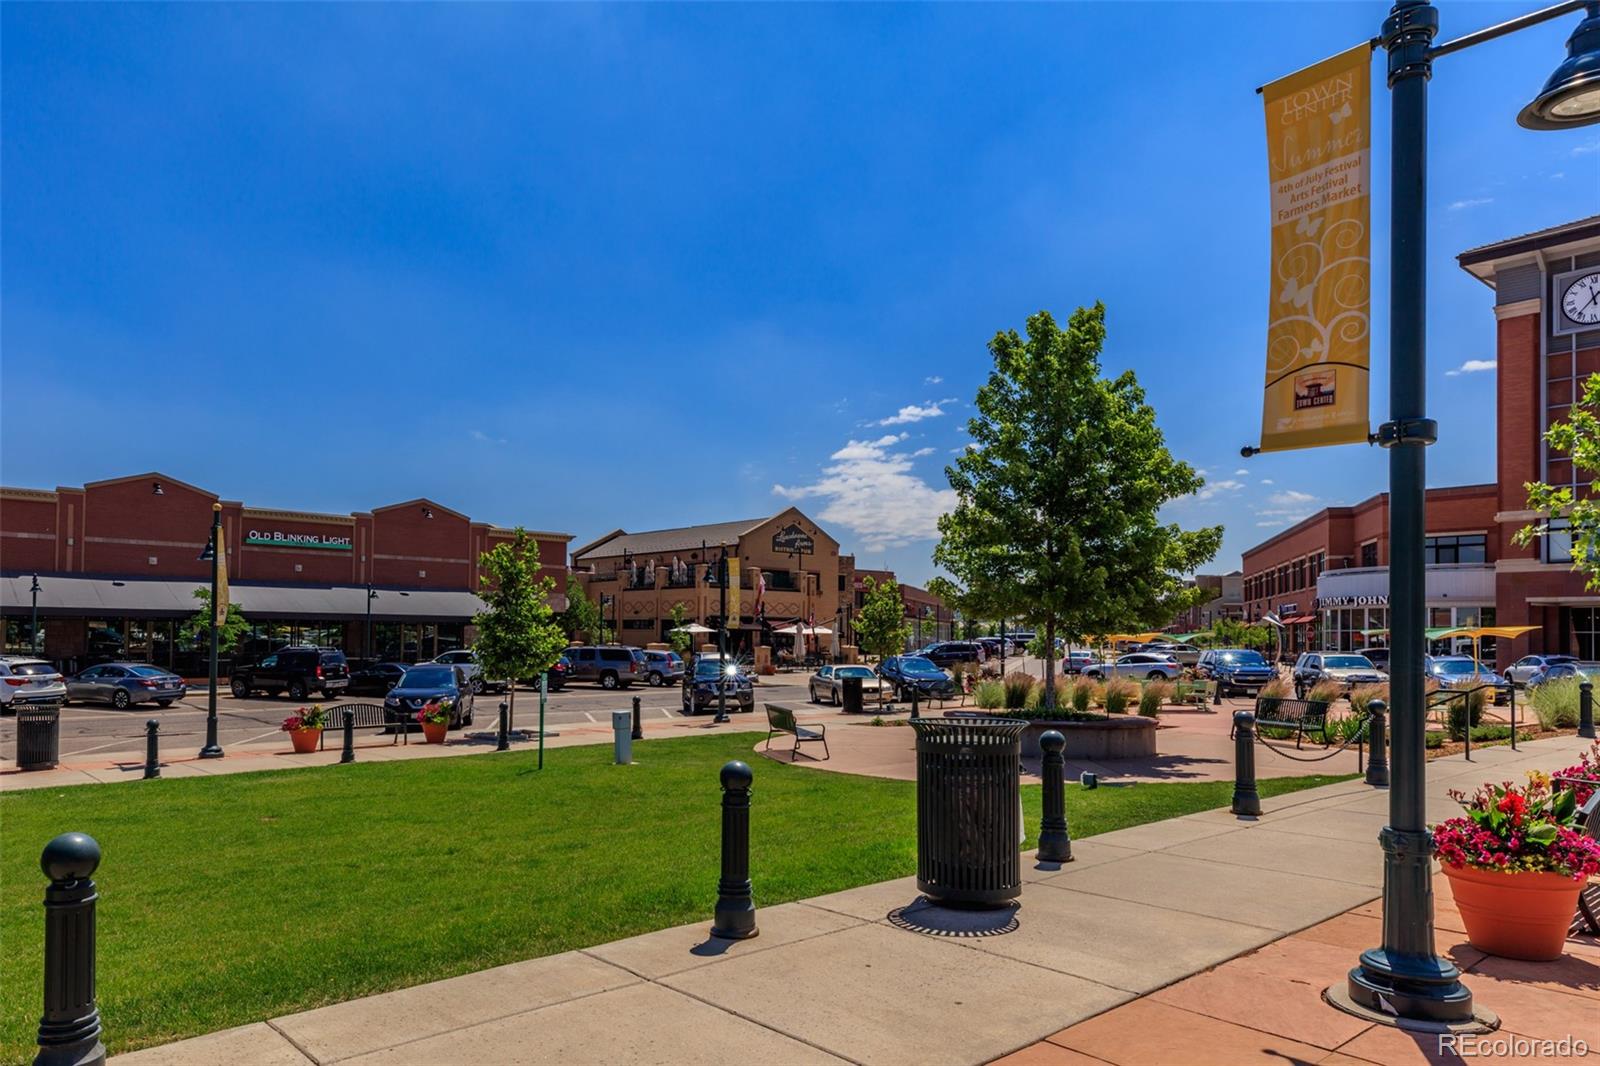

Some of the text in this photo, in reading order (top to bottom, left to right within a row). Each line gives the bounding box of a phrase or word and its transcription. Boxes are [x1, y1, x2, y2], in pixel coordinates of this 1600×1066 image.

[1281, 73, 1353, 113] TOWN
[1281, 88, 1353, 125] CENTER
[1272, 128, 1363, 171] Summer
[1278, 156, 1361, 194] 4th of July Festival
[1290, 174, 1348, 204] Arts Festival
[1278, 183, 1362, 221] Farmers Market
[249, 530, 351, 545] OLD BLINKING LIGHT
